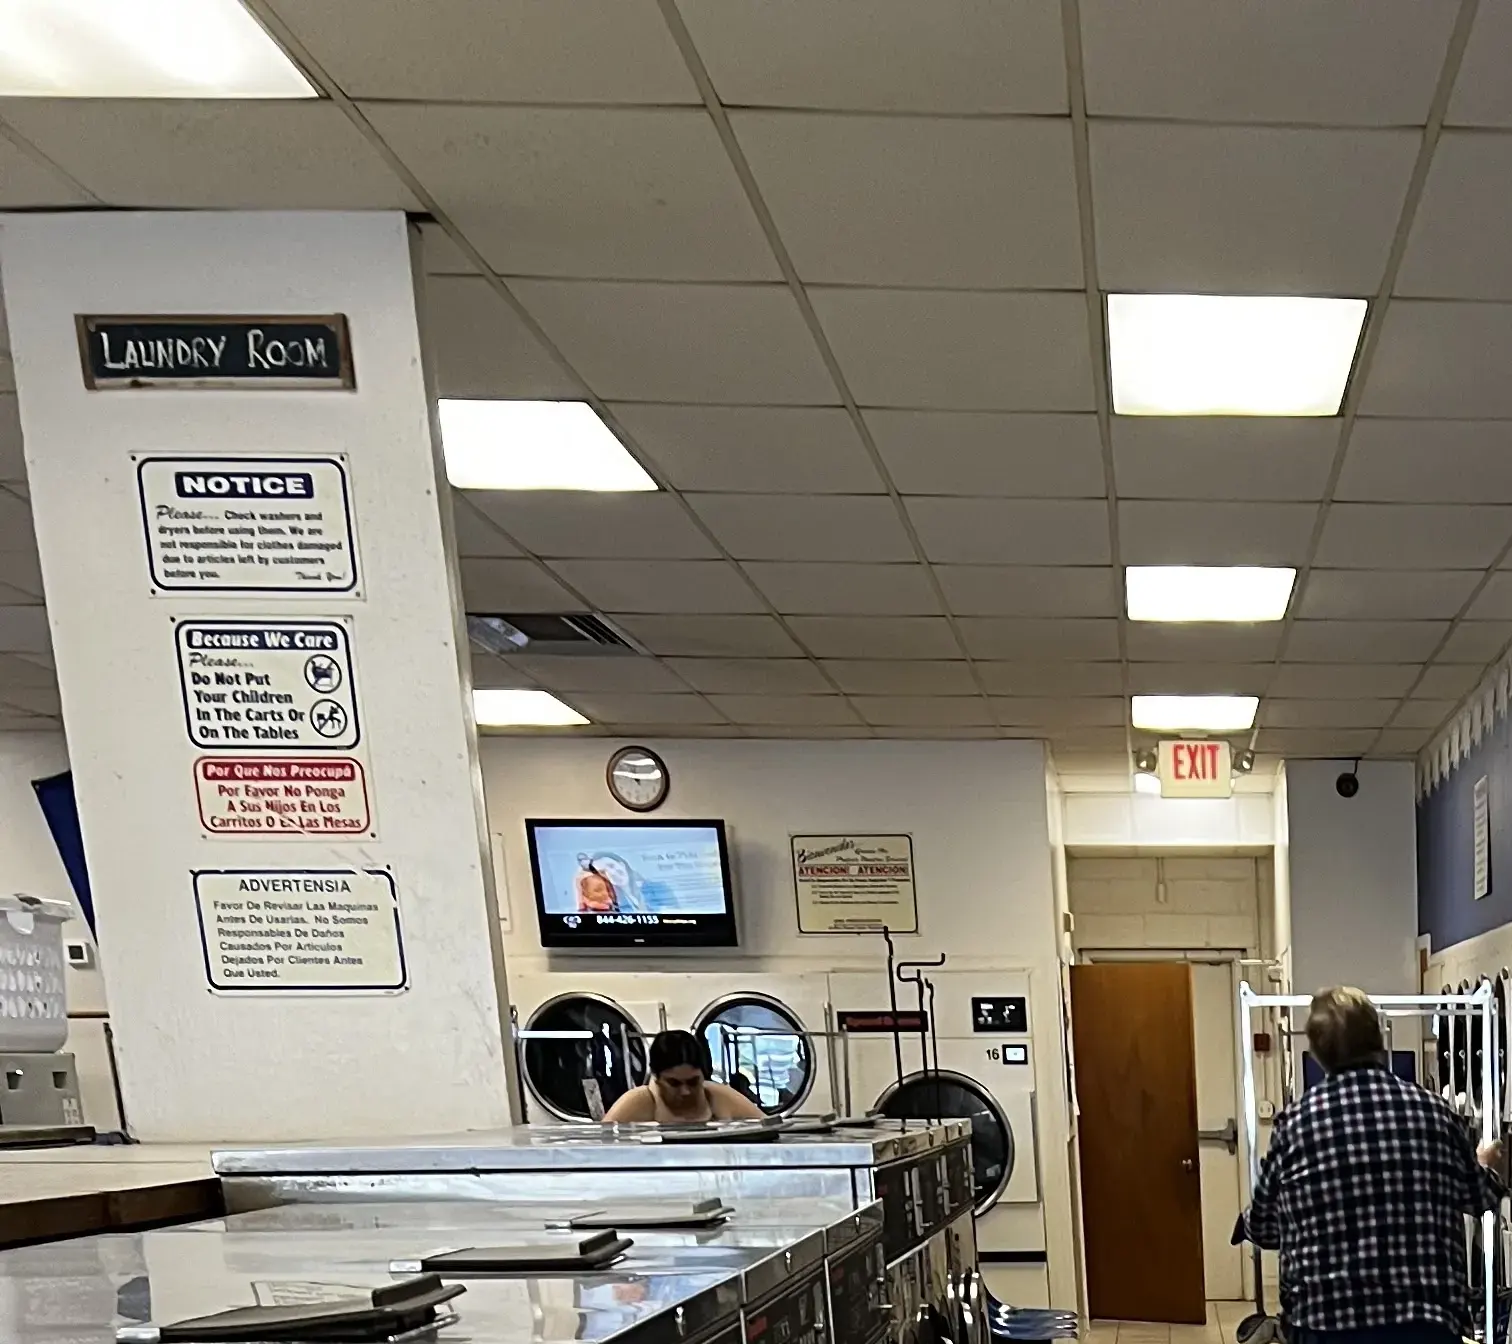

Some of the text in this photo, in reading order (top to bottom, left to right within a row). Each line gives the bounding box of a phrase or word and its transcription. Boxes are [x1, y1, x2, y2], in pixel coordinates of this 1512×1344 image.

[100, 329, 327, 369] LAUNDRY ROOM
[182, 475, 306, 495] NOTICE
[191, 631, 333, 648] Because We Care
[191, 672, 271, 686] Do Not Put
[193, 690, 293, 704] Your Children
[196, 708, 306, 721] In The Carts Or
[199, 726, 299, 739] On The Tables
[1173, 744, 1220, 779] EXIT
[206, 765, 229, 777] Por
[234, 765, 260, 778] Que
[263, 765, 287, 777] Nos
[218, 785, 345, 799] Por Favor No Ponga
[227, 800, 236, 812] A
[241, 800, 261, 812] Sus
[301, 801, 316, 812] En
[320, 801, 341, 813] Los
[210, 815, 262, 828] Carritos
[266, 816, 276, 828] O
[299, 816, 320, 828] Las
[323, 816, 361, 828] Mesas
[239, 879, 352, 893] ADVERTENSIA
[213, 901, 379, 913] Favor De Revisar Las Maquinas
[216, 915, 246, 924] Antes
[249, 915, 263, 924] De
[314, 916, 330, 925] No
[332, 916, 369, 925] Somos
[217, 928, 345, 939] Responsables De Daños
[219, 942, 272, 952] Causados
[274, 942, 293, 951] Por
[221, 955, 363, 966] Dejados Por Clientes Antes
[223, 968, 244, 978] Que
[986, 1049, 1000, 1060] 16
